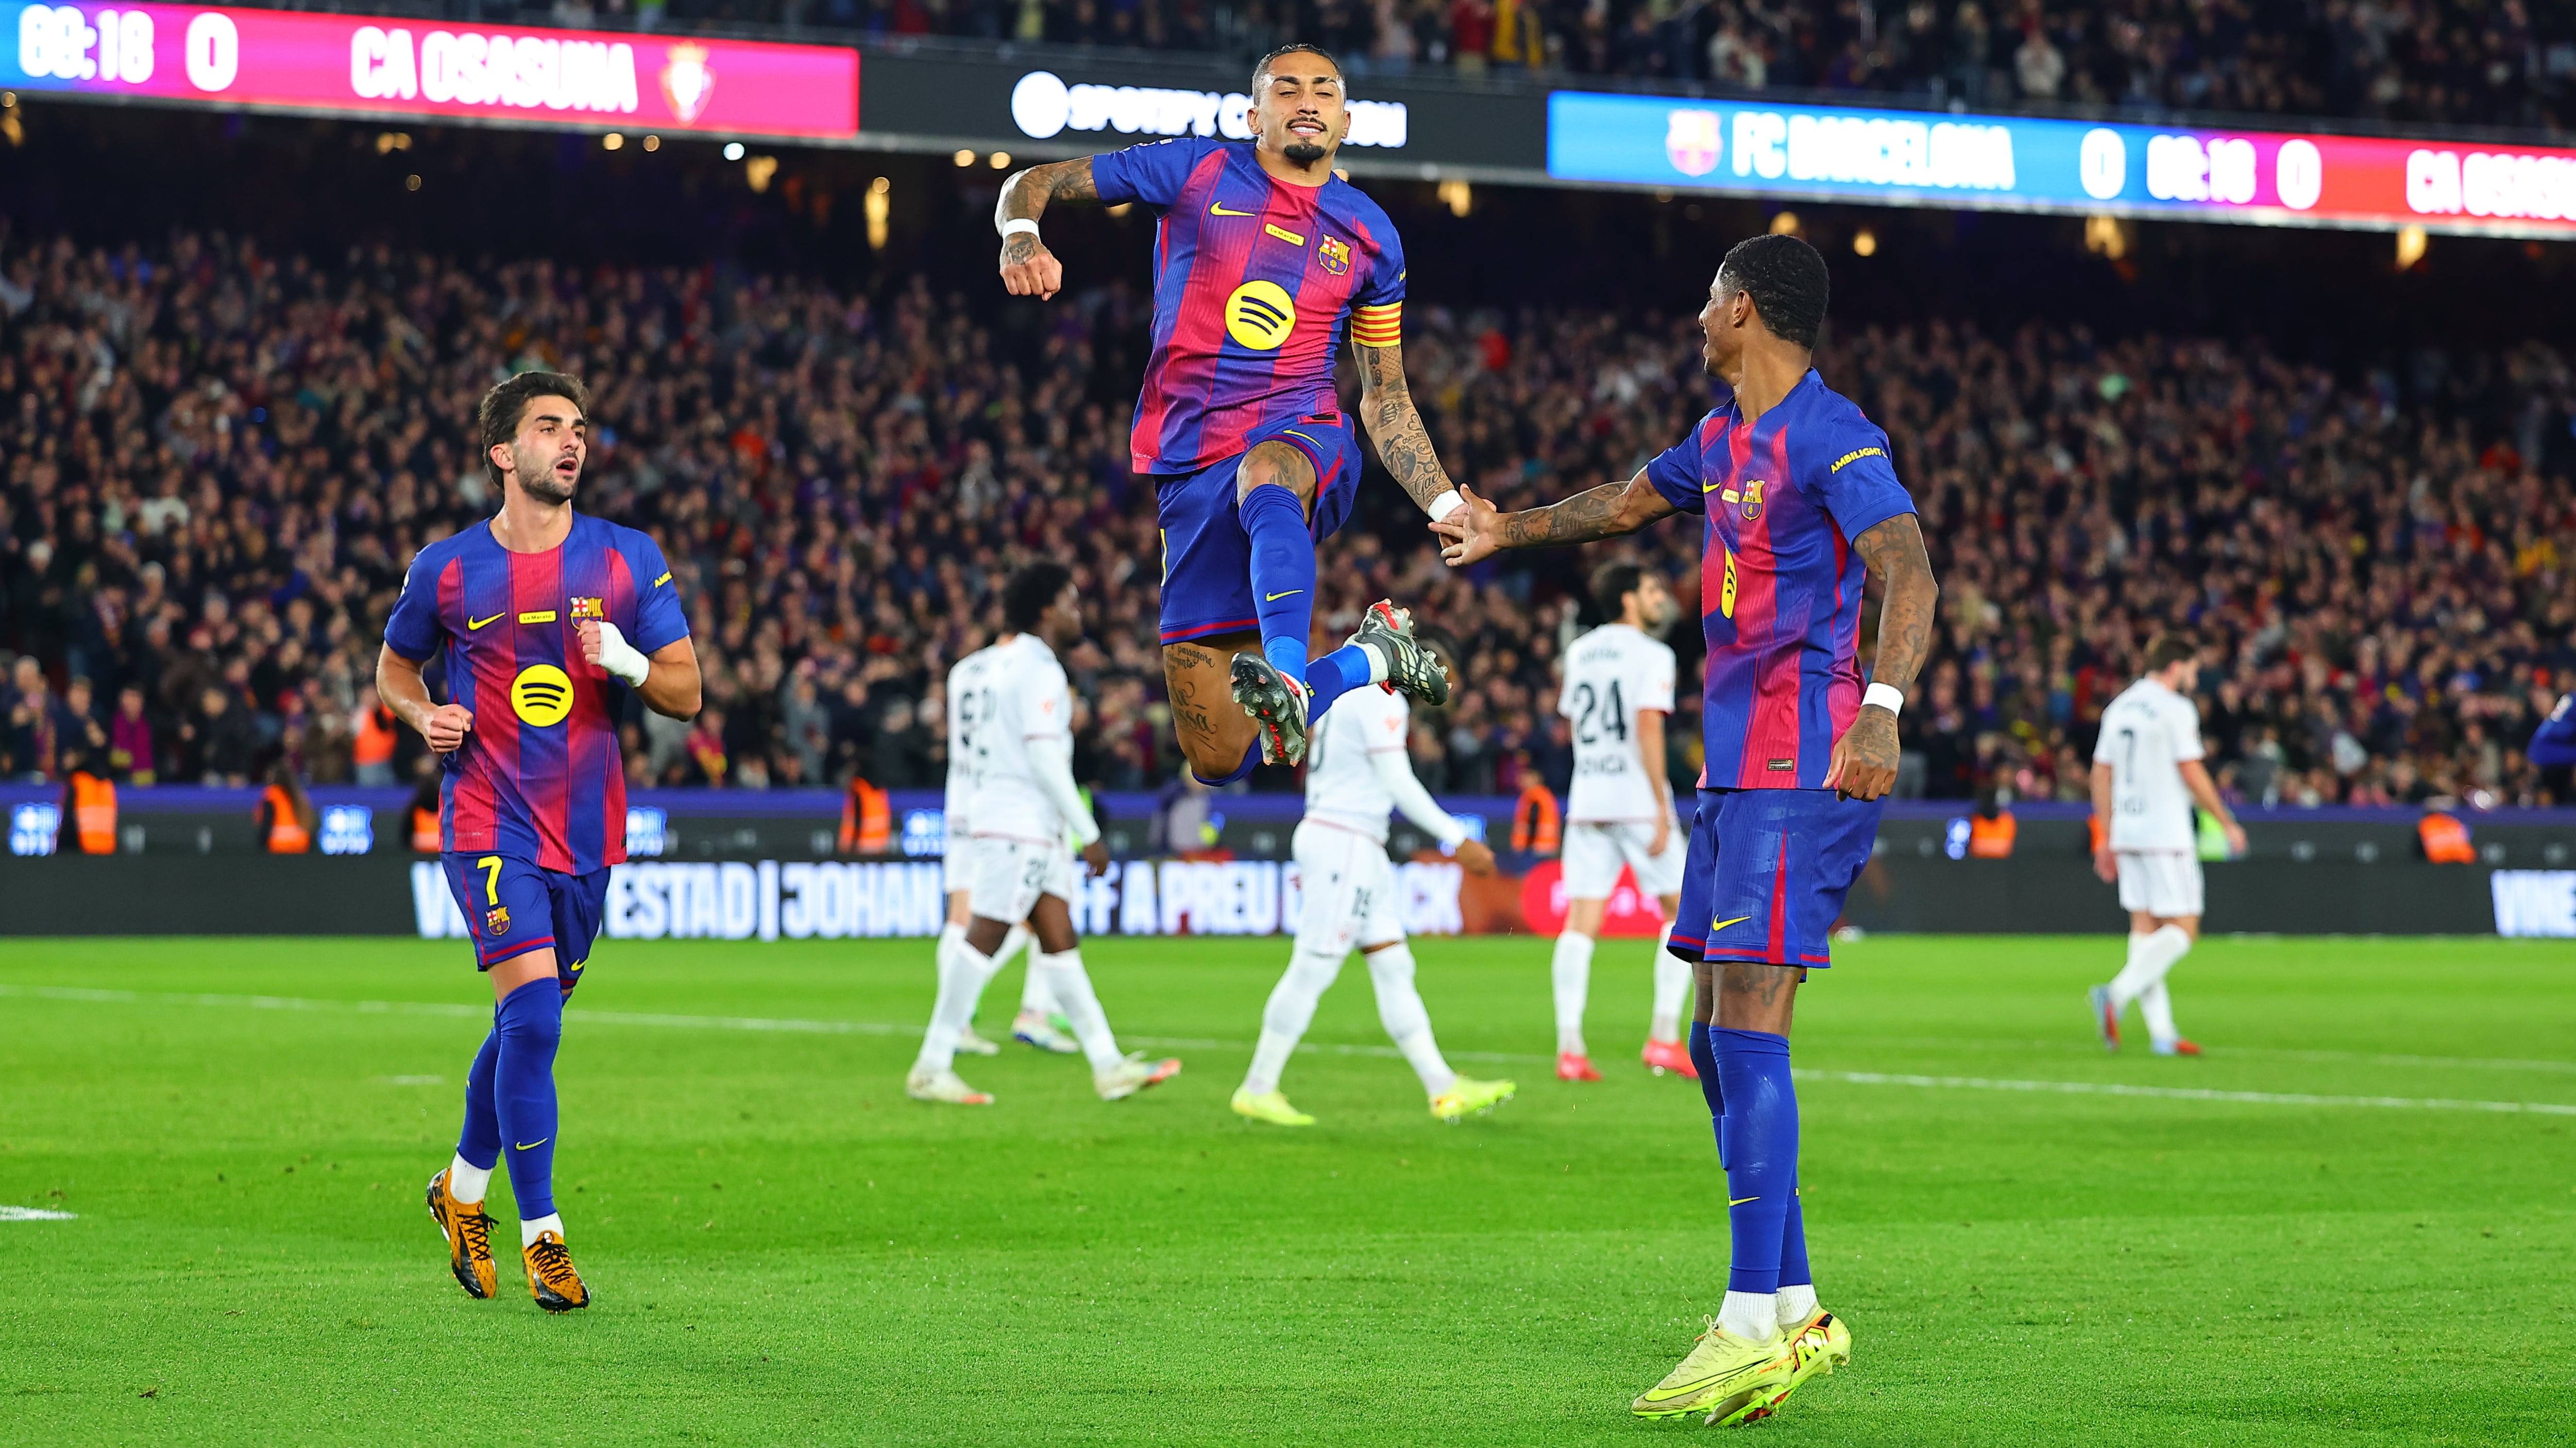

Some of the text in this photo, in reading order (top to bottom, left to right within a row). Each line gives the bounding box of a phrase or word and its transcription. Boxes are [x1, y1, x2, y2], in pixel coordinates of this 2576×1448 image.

[186, 12, 238, 92] 0
[351, 26, 418, 100] CA
[421, 31, 638, 113] OSASUNA
[1732, 110, 1787, 179] FC
[1787, 114, 2015, 190] BARCELONA
[2080, 128, 2126, 200] 0
[2276, 139, 2321, 209] 0
[2406, 149, 2462, 214] CA
[1831, 447, 1882, 474] AMBILIGHT
[1573, 678, 1626, 744] 24
[477, 855, 503, 907] 7
[781, 860, 944, 940] JOHAN
